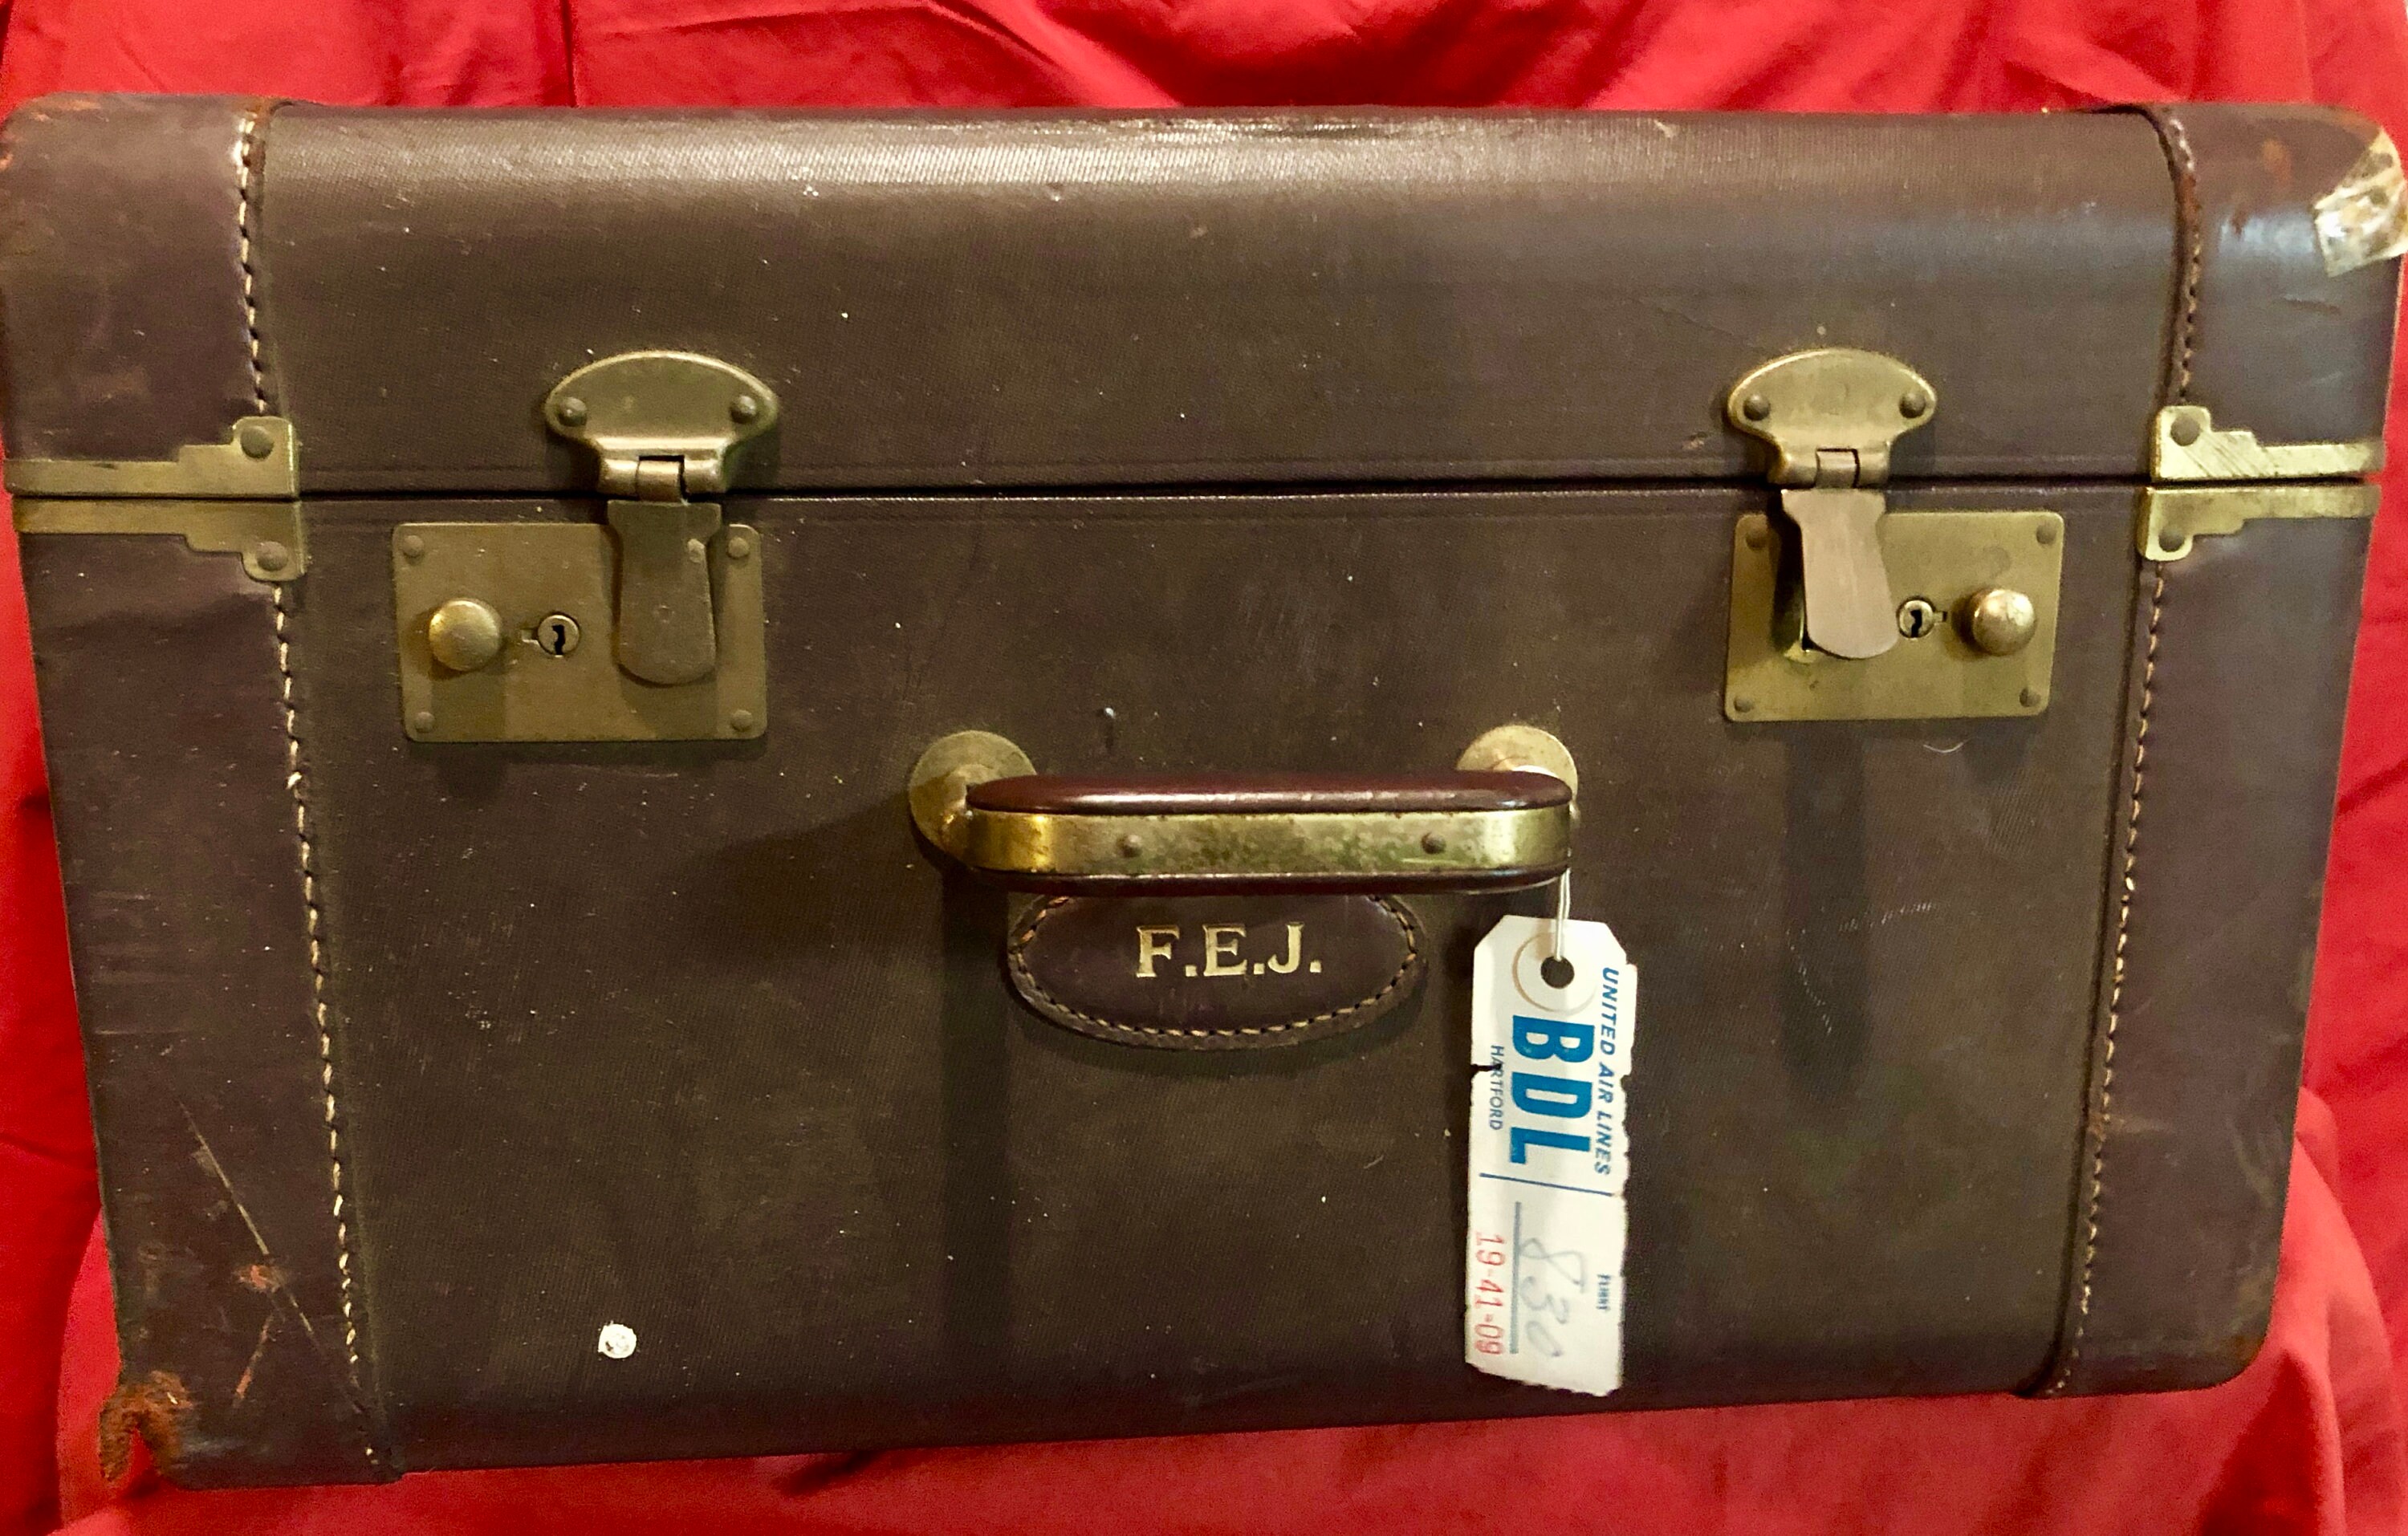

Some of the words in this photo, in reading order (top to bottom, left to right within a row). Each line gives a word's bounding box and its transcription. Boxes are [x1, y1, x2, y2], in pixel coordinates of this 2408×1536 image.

[1136, 924, 1322, 977] F.E.J.
[1600, 967, 1619, 1055] UNITED
[1489, 1045, 1505, 1131] HARTFORD
[1510, 1015, 1595, 1164] BDL
[1598, 1062, 1615, 1103] AIR
[1595, 1111, 1613, 1174] LINES
[1519, 1237, 1586, 1356] 830
